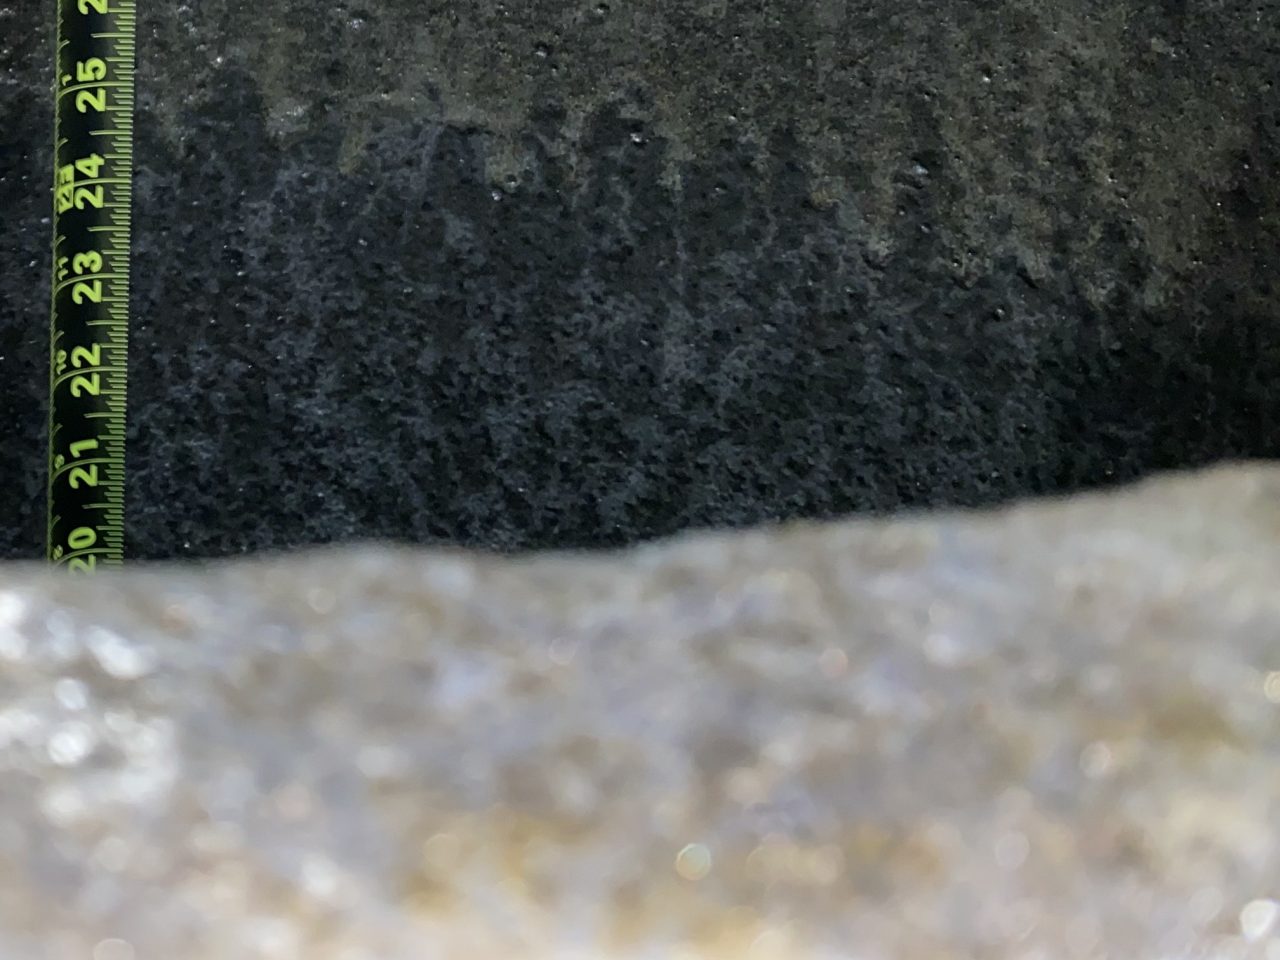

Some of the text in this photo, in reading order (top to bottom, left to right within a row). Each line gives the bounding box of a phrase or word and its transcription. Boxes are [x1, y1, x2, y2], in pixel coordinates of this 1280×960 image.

[61, 74, 72, 86] 1
[75, 57, 107, 113] 25
[74, 153, 105, 210] 24
[57, 256, 69, 280] 11
[72, 250, 103, 304] 23
[70, 343, 101, 397] 22
[68, 439, 99, 489] 21
